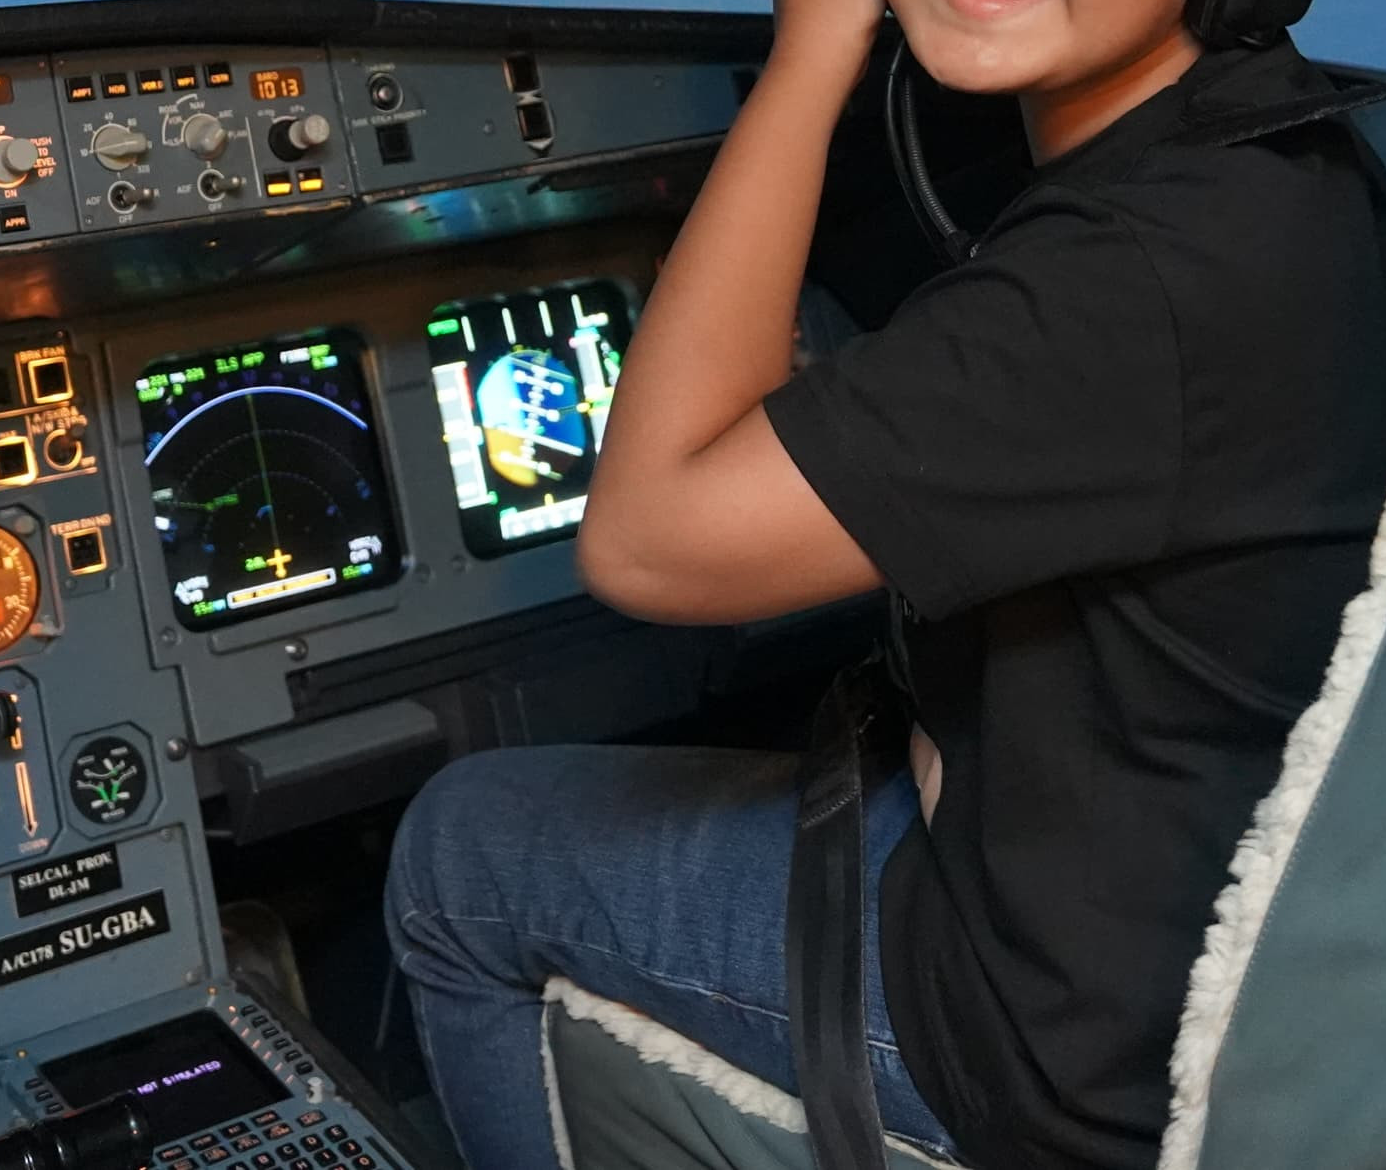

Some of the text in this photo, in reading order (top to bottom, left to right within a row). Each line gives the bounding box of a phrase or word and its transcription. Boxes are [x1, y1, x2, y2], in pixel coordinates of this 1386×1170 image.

[258, 78, 300, 100] 1013
[38, 147, 49, 157] TO
[37, 167, 55, 178] OFF
[4, 188, 18, 199] DN
[85, 196, 102, 207] ADF
[17, 864, 73, 890] SELCAL
[47, 877, 91, 901] DL-JM
[0, 905, 156, 974] A/C178 SU-GBA
[136, 1059, 224, 1096] NOT SIMULATED
